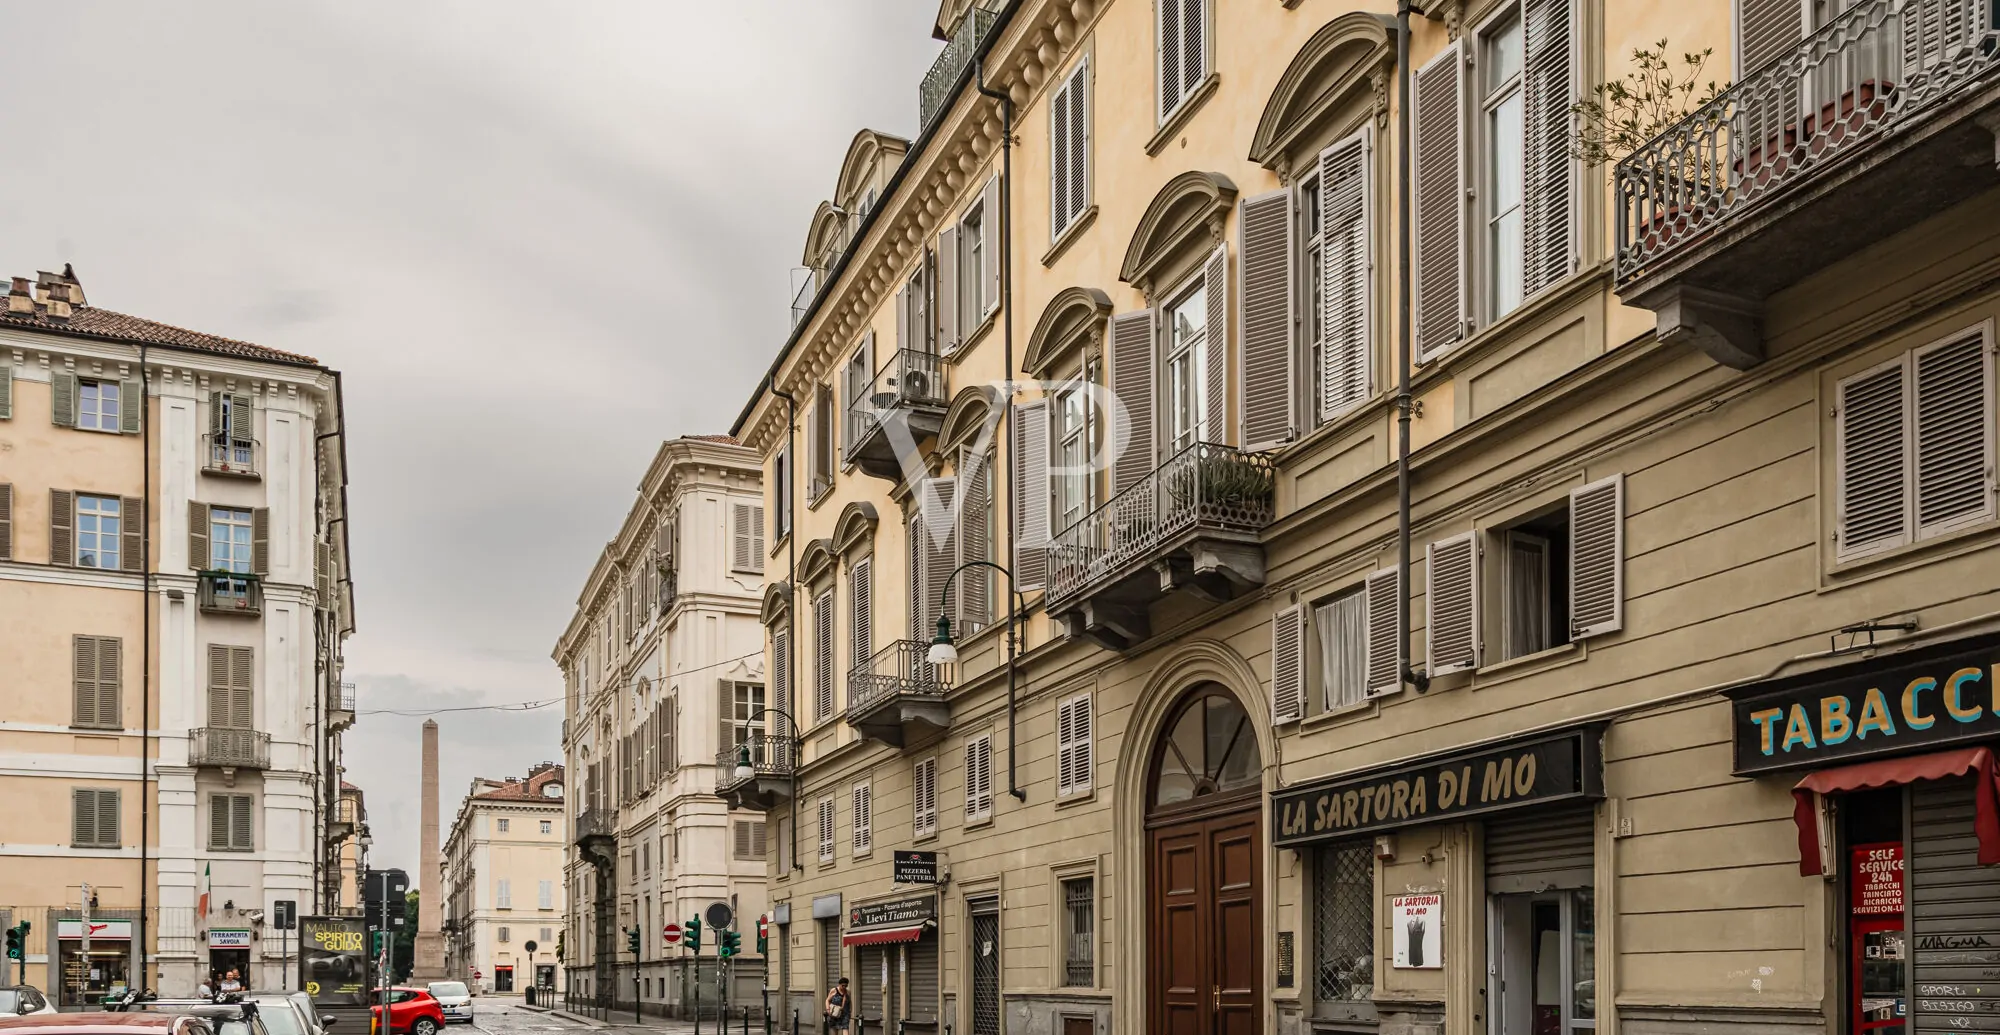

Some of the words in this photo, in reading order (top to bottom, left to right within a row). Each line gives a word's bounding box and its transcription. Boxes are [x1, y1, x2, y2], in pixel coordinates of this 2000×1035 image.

[1281, 801, 1307, 836] LA
[1313, 776, 1427, 831] SARTORA
[1437, 766, 1471, 810] DI
[1480, 752, 1537, 803] MO
[1869, 848, 1895, 861] SELF
[1859, 859, 1905, 873] SERVICE
[1871, 871, 1893, 883] 24h
[1864, 882, 1900, 891] TABACCHI
[1394, 898, 1403, 907] LA
[1404, 896, 1439, 907] SARTORIA
[1863, 897, 1902, 906] RICARICHE
[1406, 908, 1414, 916] DI
[1415, 907, 1427, 915] MO
[315, 932, 363, 942] SPIRITO
[1920, 935, 1991, 949] MAGMA
[324, 941, 363, 951] GUIDA
